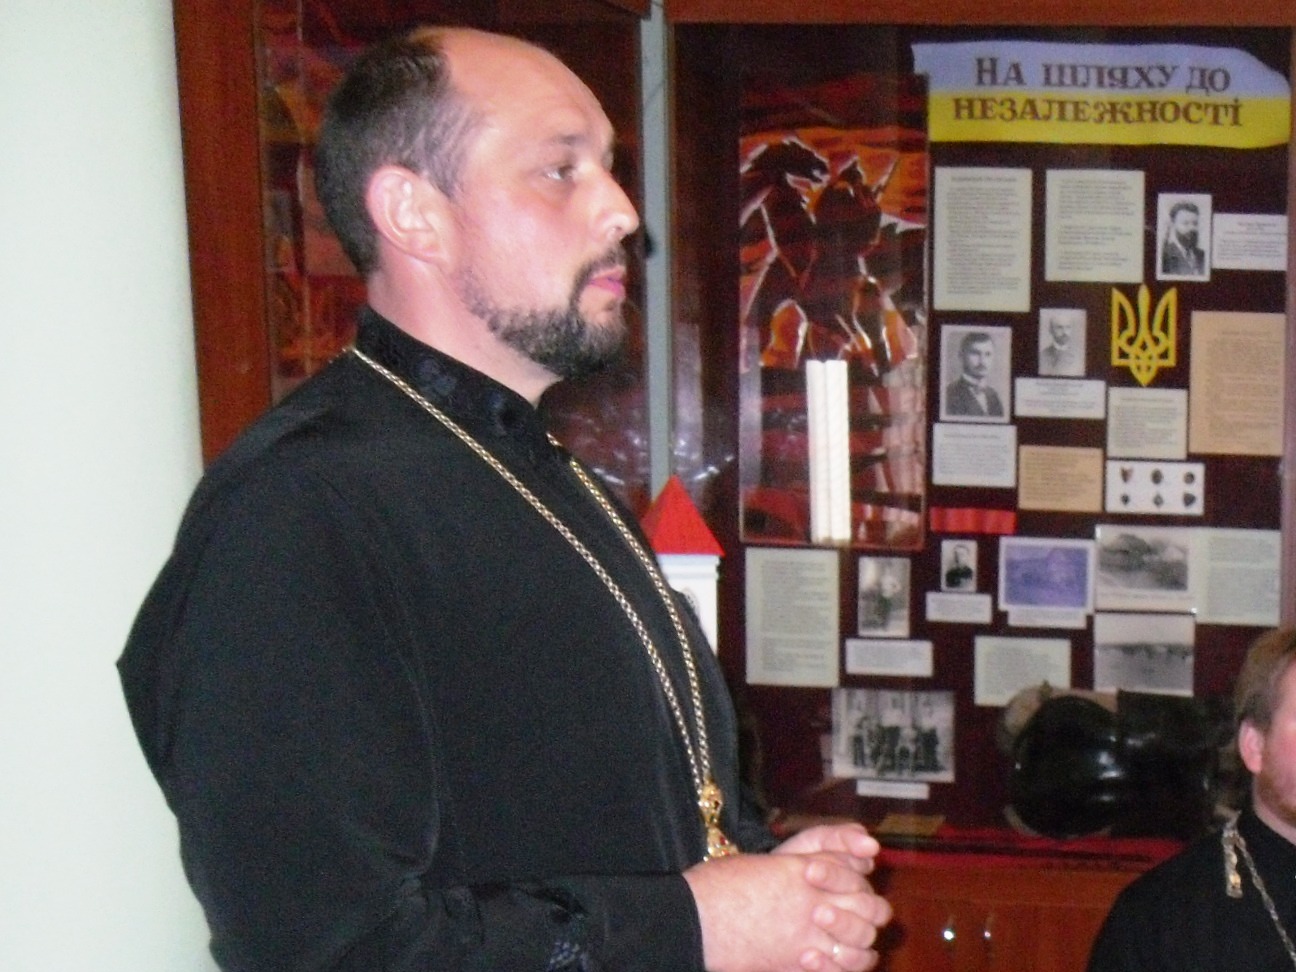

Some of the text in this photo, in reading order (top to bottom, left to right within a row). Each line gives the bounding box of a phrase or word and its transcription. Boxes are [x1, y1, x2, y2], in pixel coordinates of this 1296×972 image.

[975, 56, 1231, 96] НА ШЛЯХУ ДО
[952, 97, 1244, 127] НЕЗАЛЕЖНОСТІ
